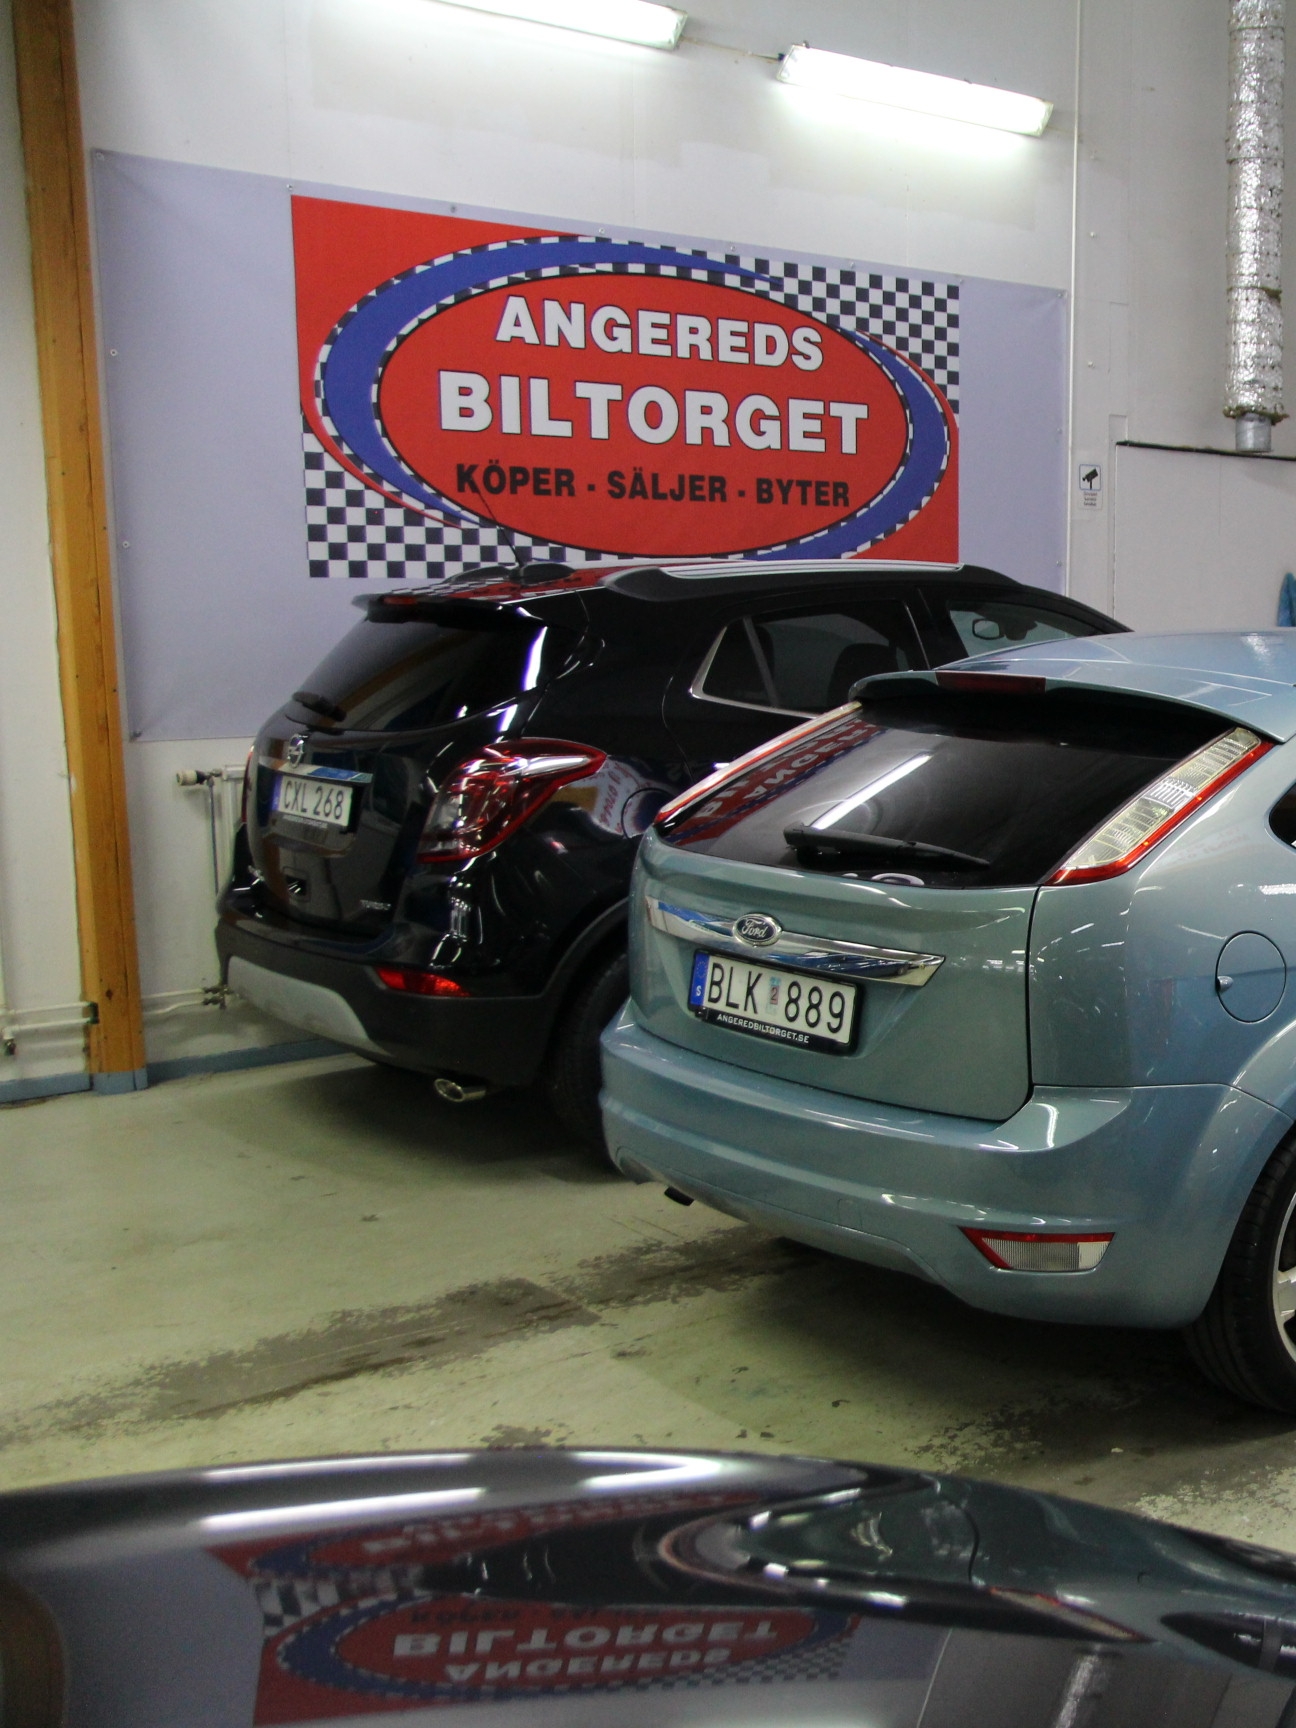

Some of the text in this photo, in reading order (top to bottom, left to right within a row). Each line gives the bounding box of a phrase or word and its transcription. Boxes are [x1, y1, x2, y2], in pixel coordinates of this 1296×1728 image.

[495, 295, 824, 372] ANGEREDS
[437, 369, 869, 455] BILTORGET
[455, 459, 850, 509] KÖPER SÄLJER BYTER
[284, 780, 344, 820] CXL 268
[741, 918, 769, 940] Ford
[708, 962, 846, 1034] BLK 889
[716, 1013, 810, 1044] ANGEREDBILTORGET.SE
